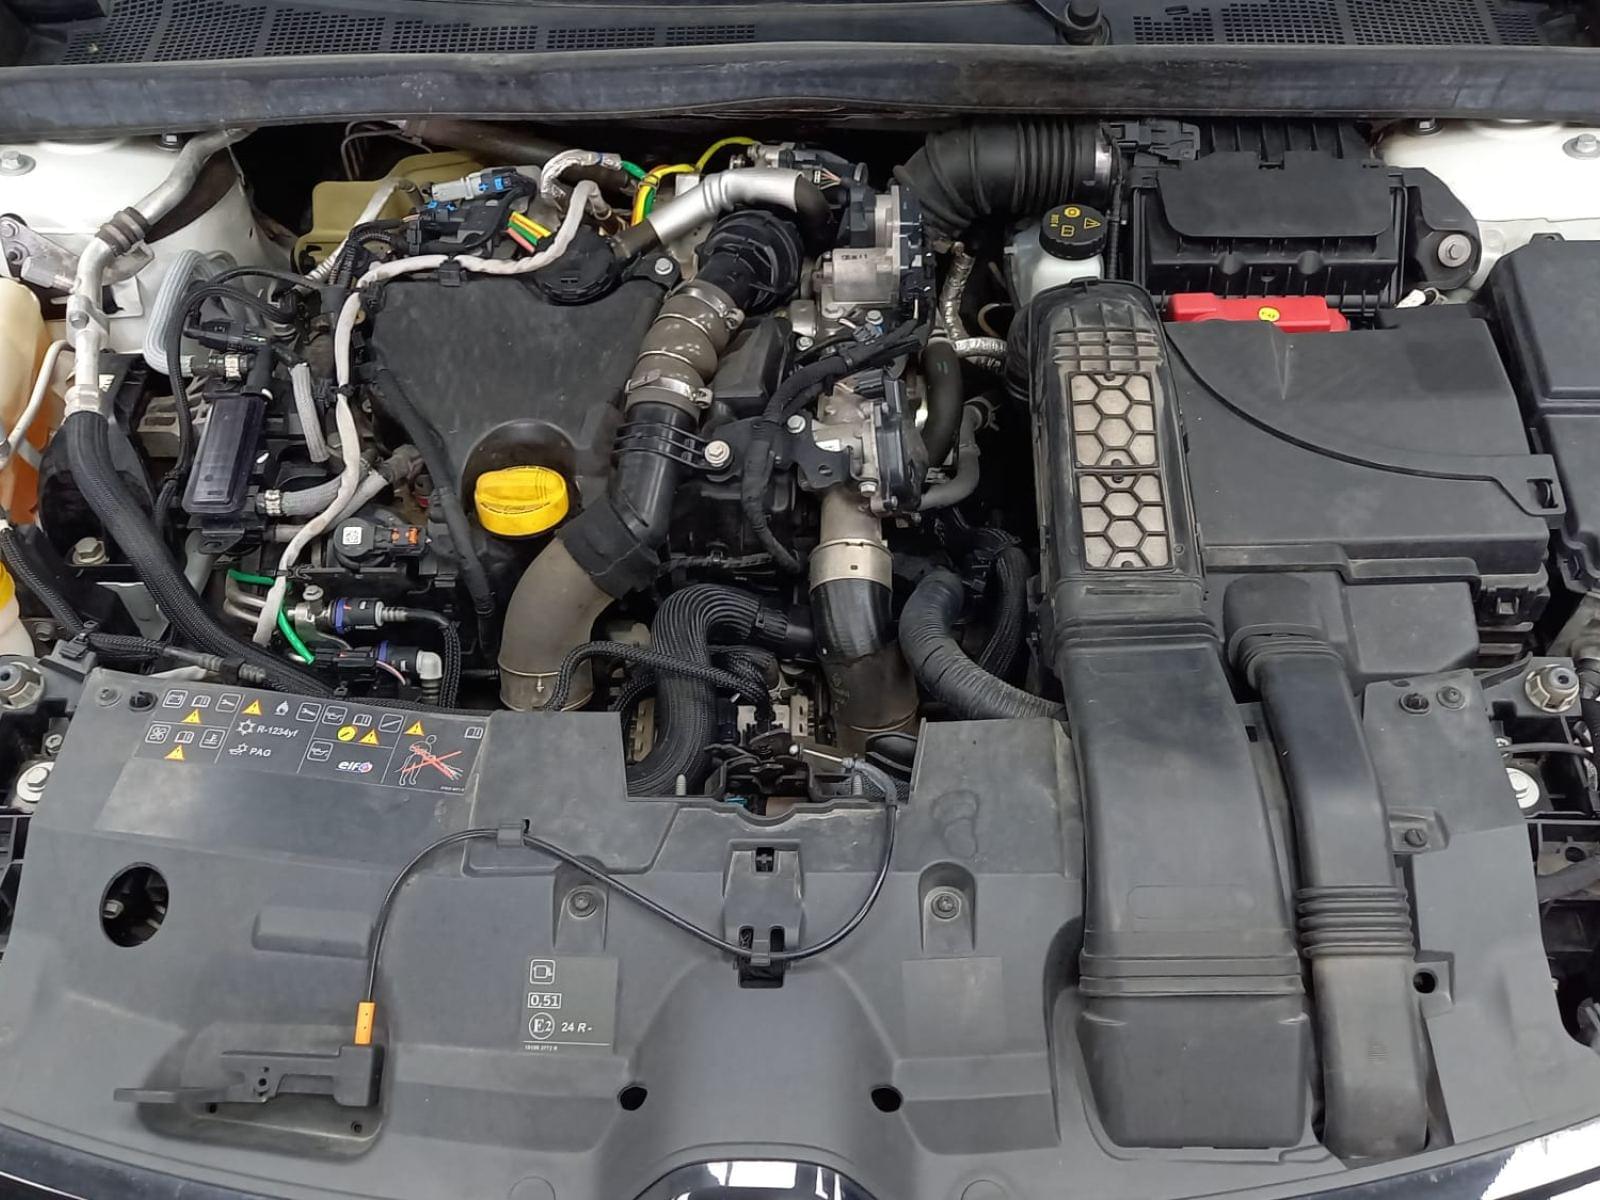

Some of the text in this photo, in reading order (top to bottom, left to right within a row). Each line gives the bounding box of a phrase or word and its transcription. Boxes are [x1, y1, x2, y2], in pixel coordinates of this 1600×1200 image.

[256, 725, 299, 738] R-1234yf
[249, 747, 272, 757] PAG
[533, 1018, 552, 1033] E2
[561, 1021, 575, 1032] 24
